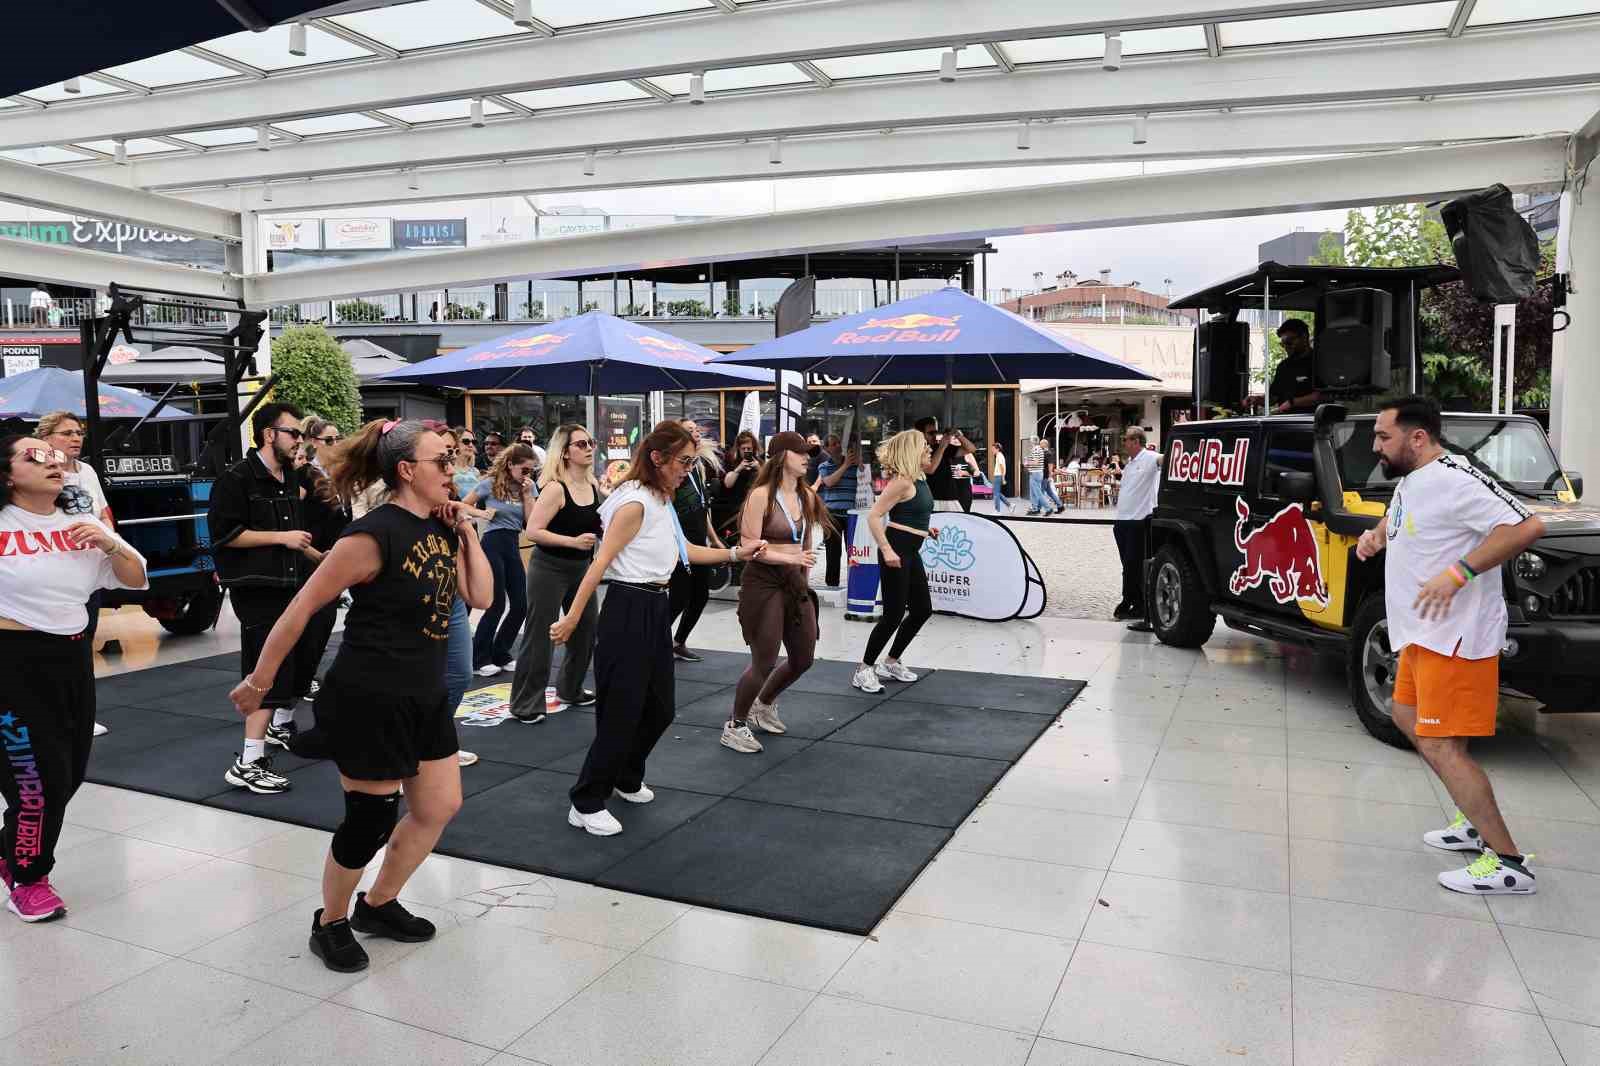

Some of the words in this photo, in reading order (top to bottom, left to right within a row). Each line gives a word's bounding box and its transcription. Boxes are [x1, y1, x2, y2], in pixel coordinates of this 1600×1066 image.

[831, 330, 896, 345] Red
[896, 328, 961, 342] Bull
[1168, 438, 1205, 482] Red
[1201, 438, 1249, 486] Bull
[927, 585, 970, 597] ELEDİYESİ
